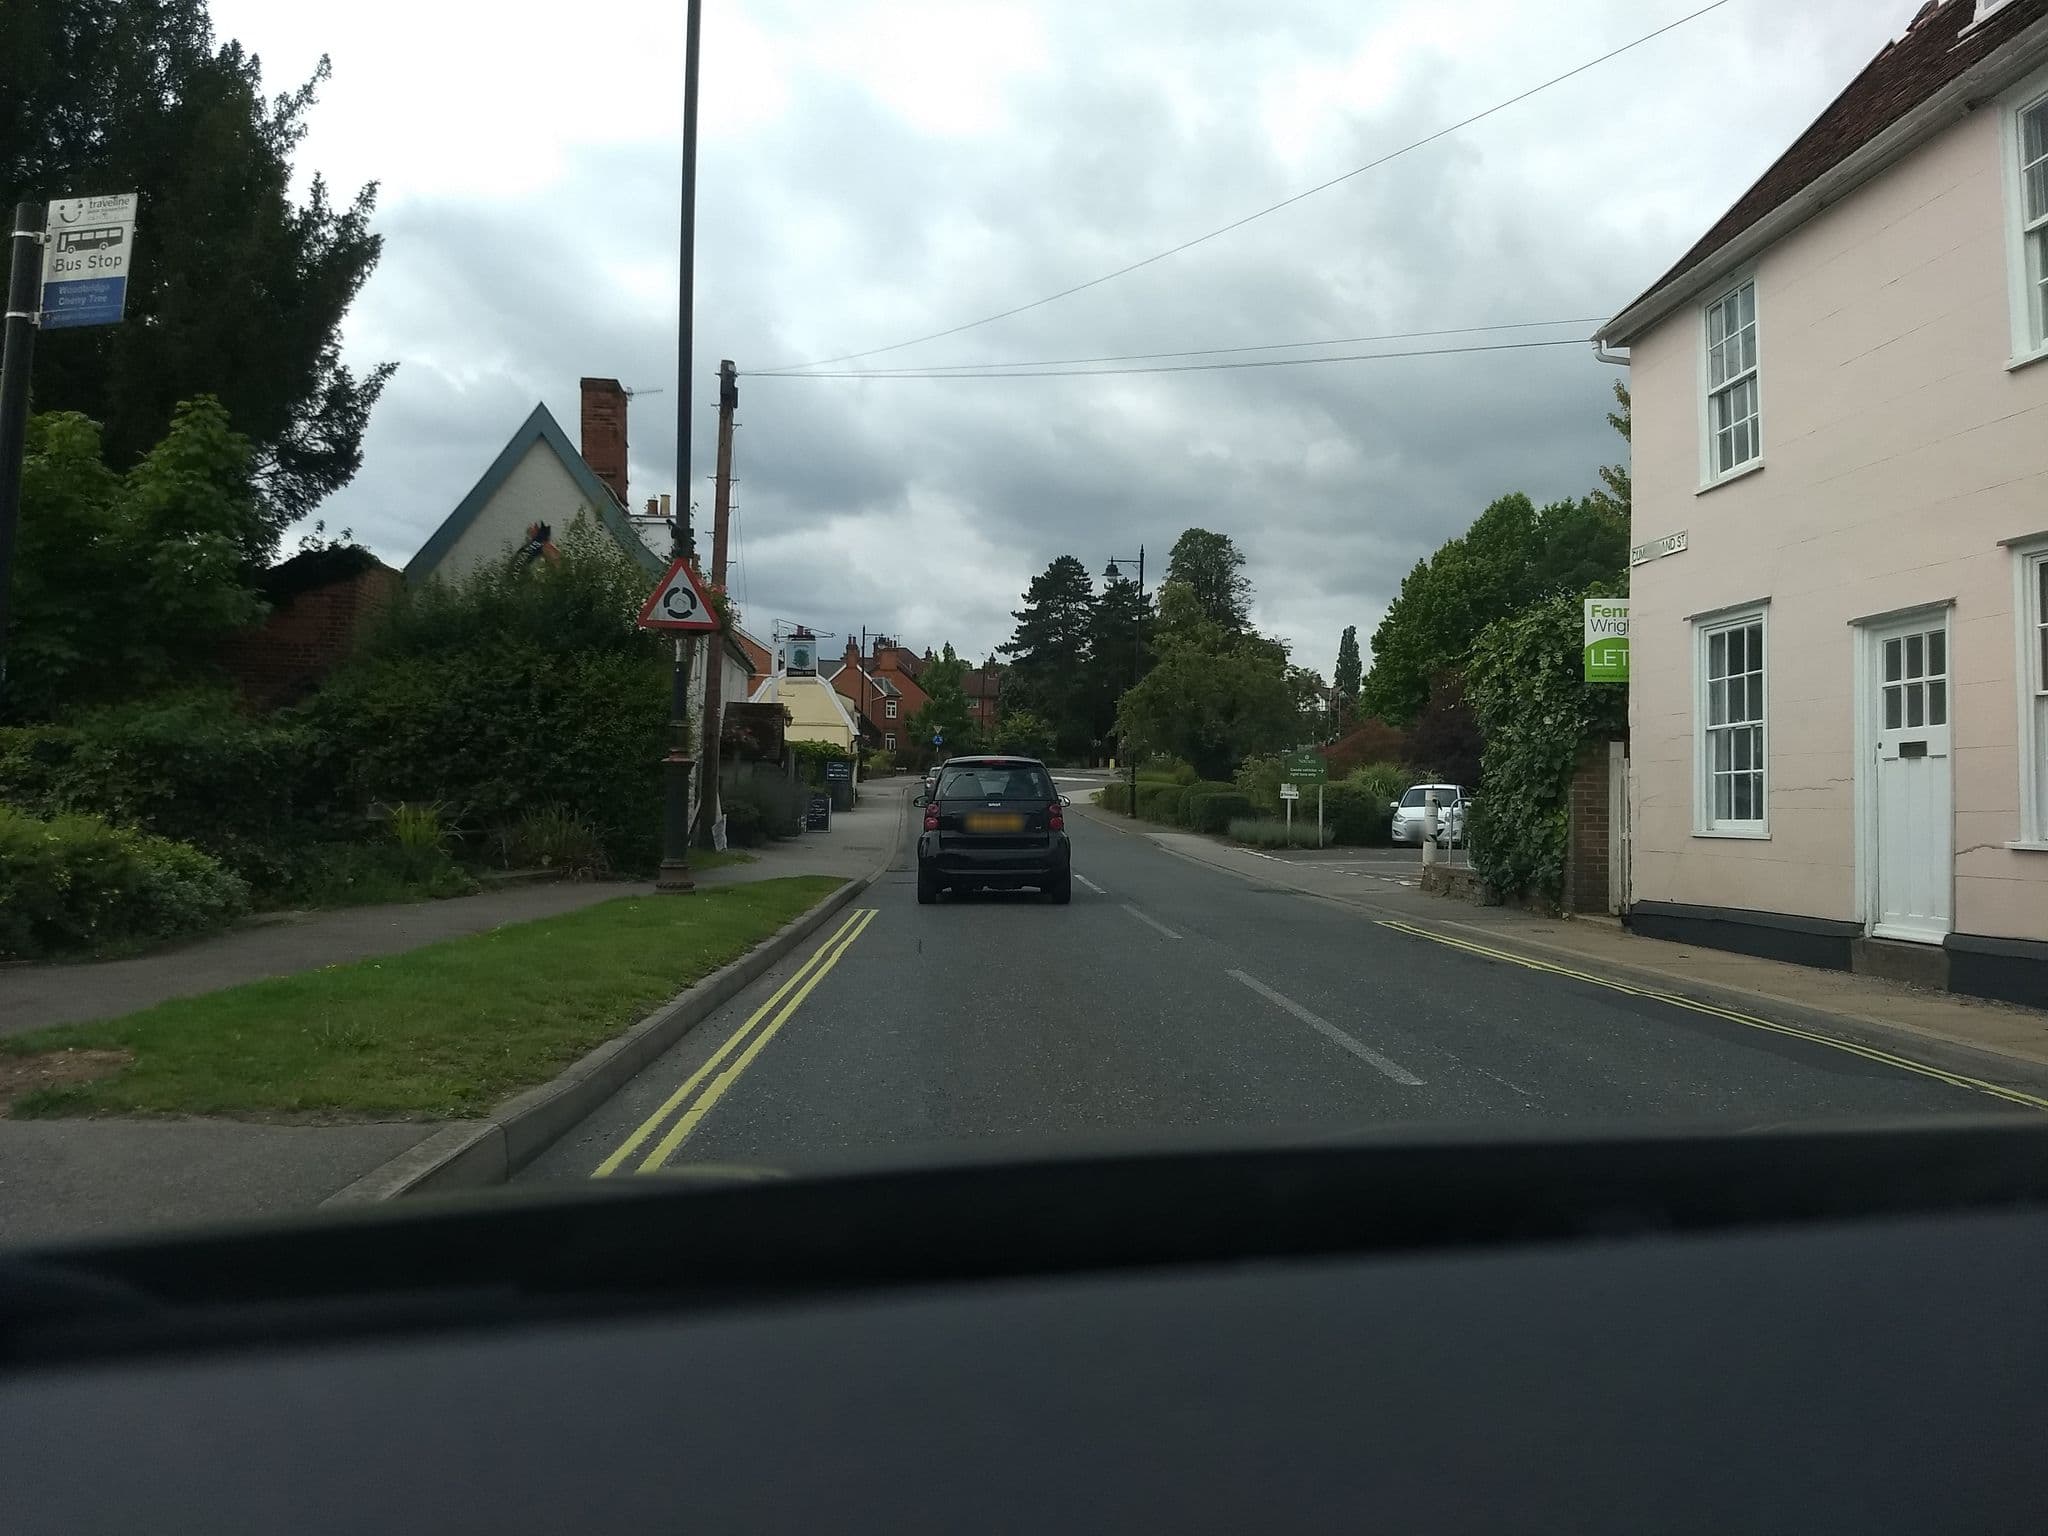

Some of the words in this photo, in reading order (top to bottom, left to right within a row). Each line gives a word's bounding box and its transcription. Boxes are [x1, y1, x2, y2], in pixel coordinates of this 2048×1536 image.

[55, 259, 82, 272] Bus
[88, 256, 122, 269] Stop
[1591, 649, 1629, 666] LET
